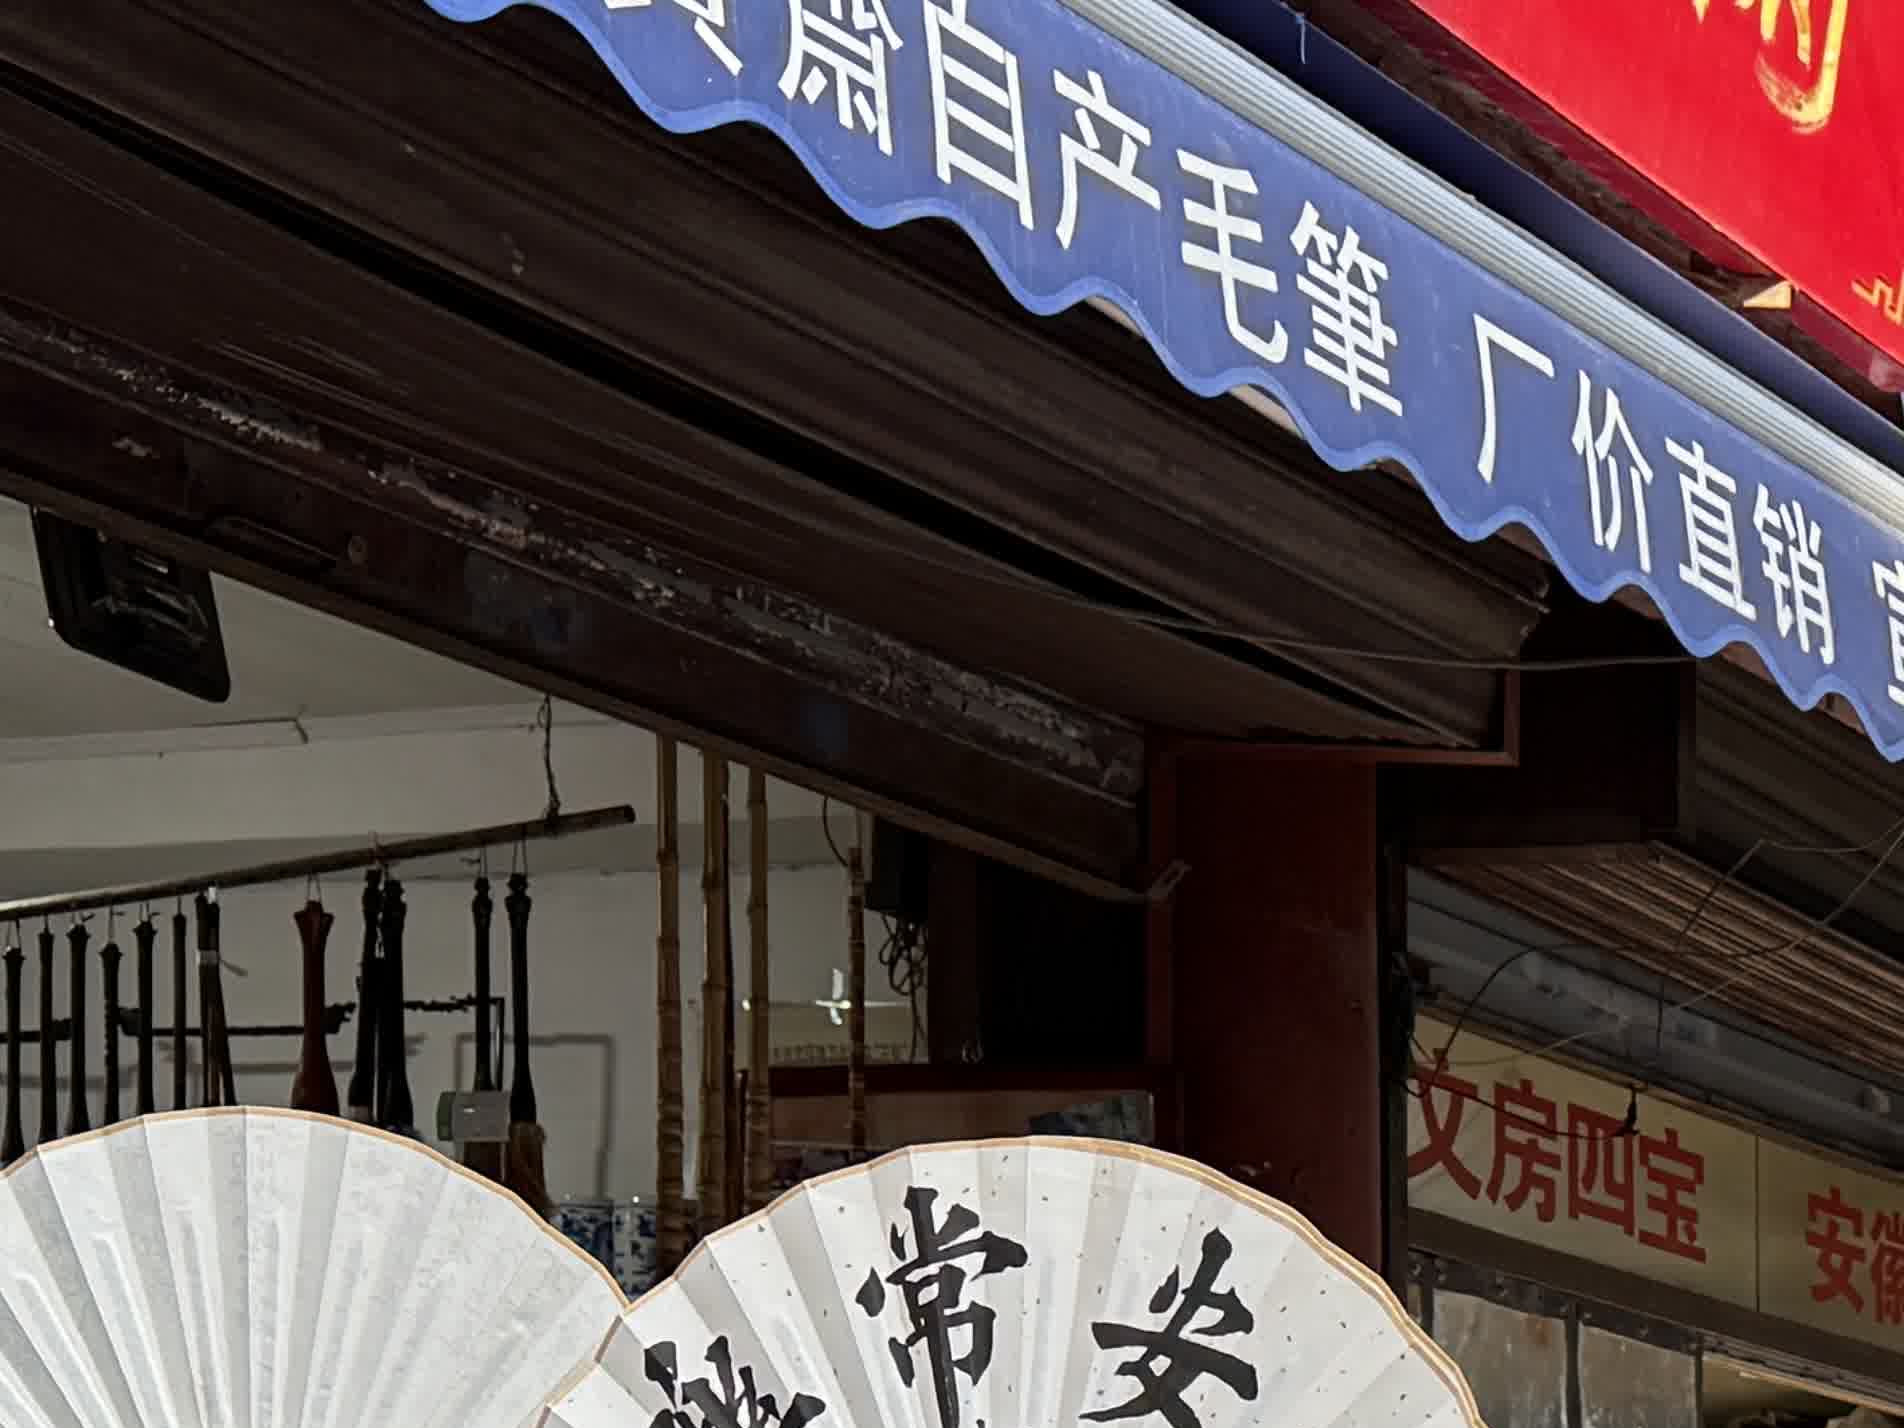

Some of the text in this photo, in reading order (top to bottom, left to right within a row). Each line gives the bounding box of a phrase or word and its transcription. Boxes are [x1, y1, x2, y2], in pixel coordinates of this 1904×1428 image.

[1474, 314, 1837, 665] 厂价直销
[1406, 1048, 1708, 1265] 文房四宝
